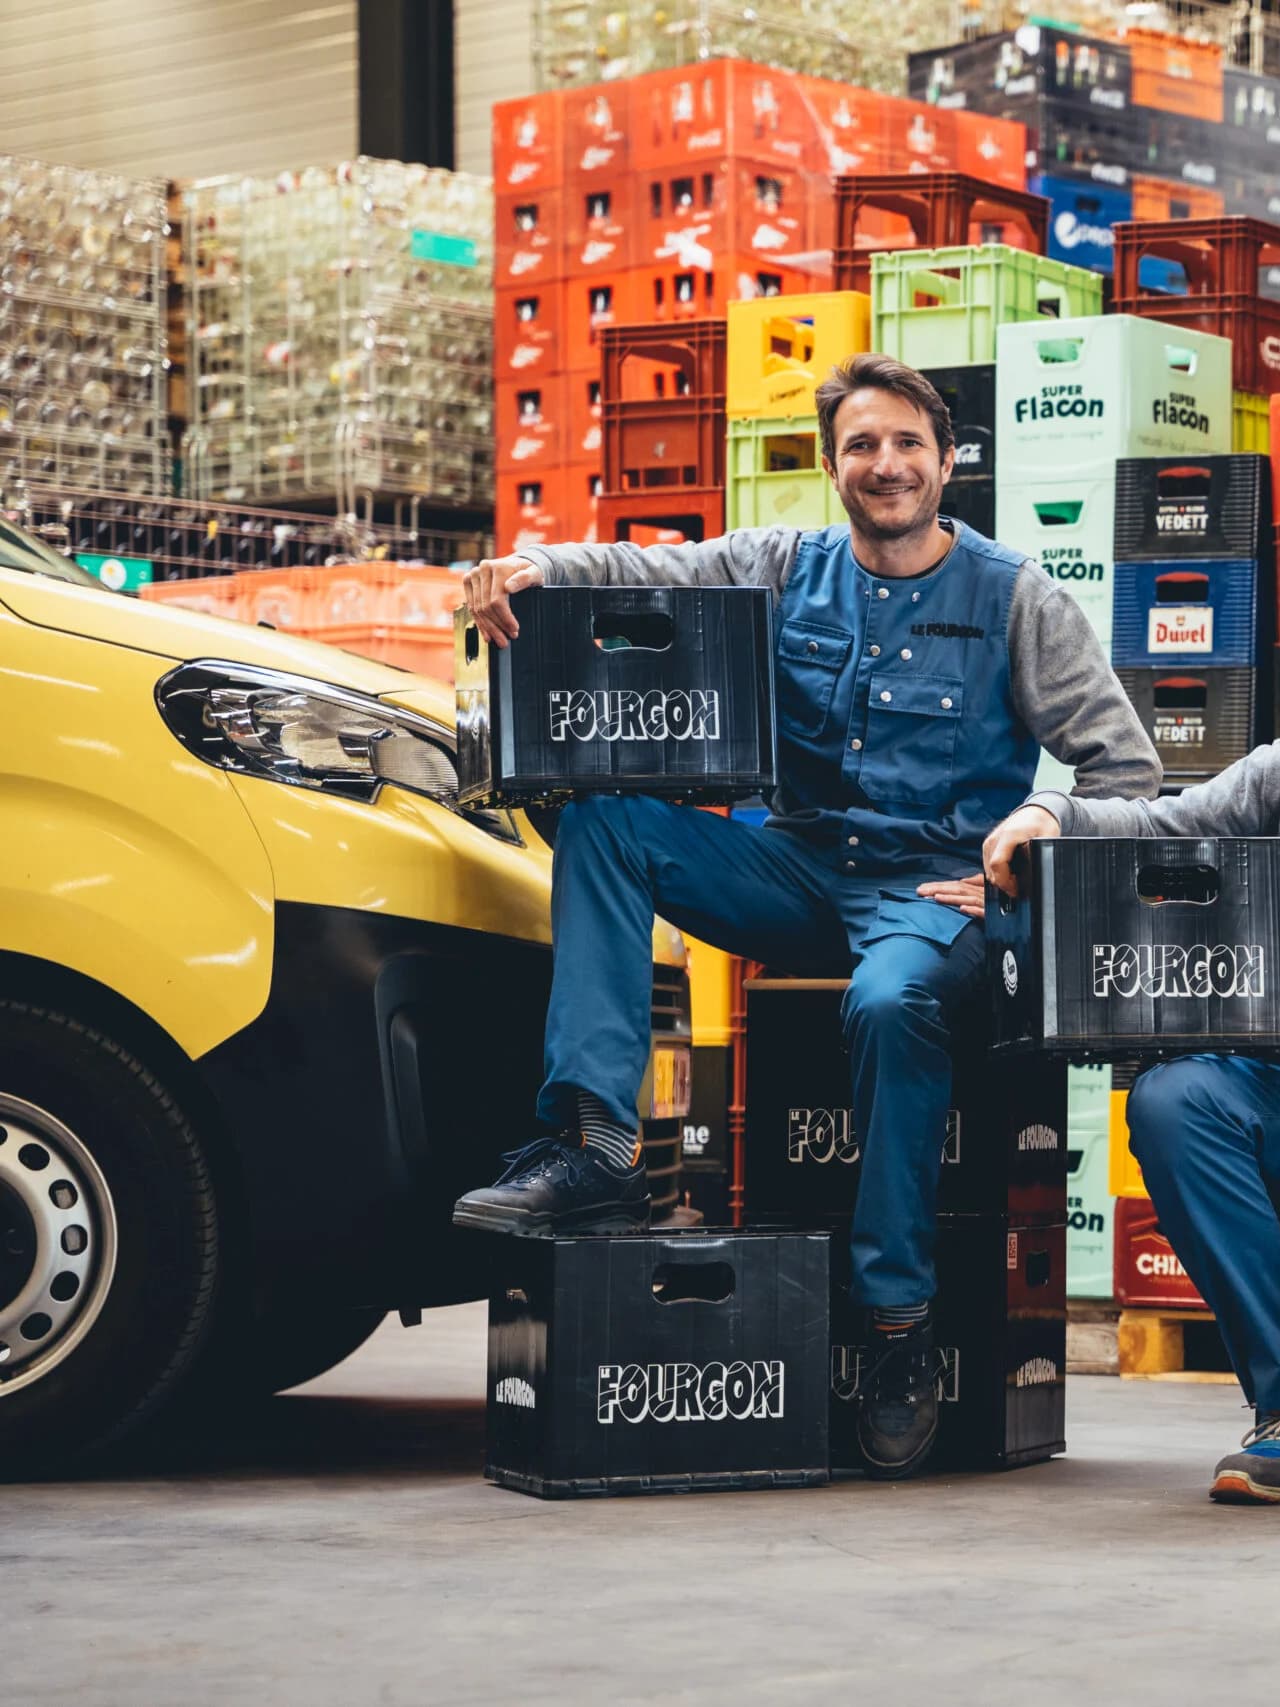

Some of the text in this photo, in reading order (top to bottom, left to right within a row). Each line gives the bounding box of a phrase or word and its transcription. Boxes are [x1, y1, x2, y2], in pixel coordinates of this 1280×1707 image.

[1041, 385, 1082, 398] SUPER
[1169, 392, 1195, 407] SUPER
[1015, 397, 1103, 422] Flacon
[1152, 399, 1208, 434] Flacon
[1155, 514, 1208, 530] VEDETT
[1042, 548, 1082, 560] SUPER
[1042, 562, 1103, 581] acon
[1156, 623, 1205, 643] Duvel
[549, 690, 720, 742] FOURGON
[1152, 726, 1206, 742] VEDETT
[1093, 944, 1264, 997] FOURGON
[1018, 1123, 1057, 1151] LE FOURGON
[1024, 1357, 1056, 1386] FOURGON
[504, 1377, 535, 1409] FOURGON
[598, 1360, 784, 1424] FOURGON
